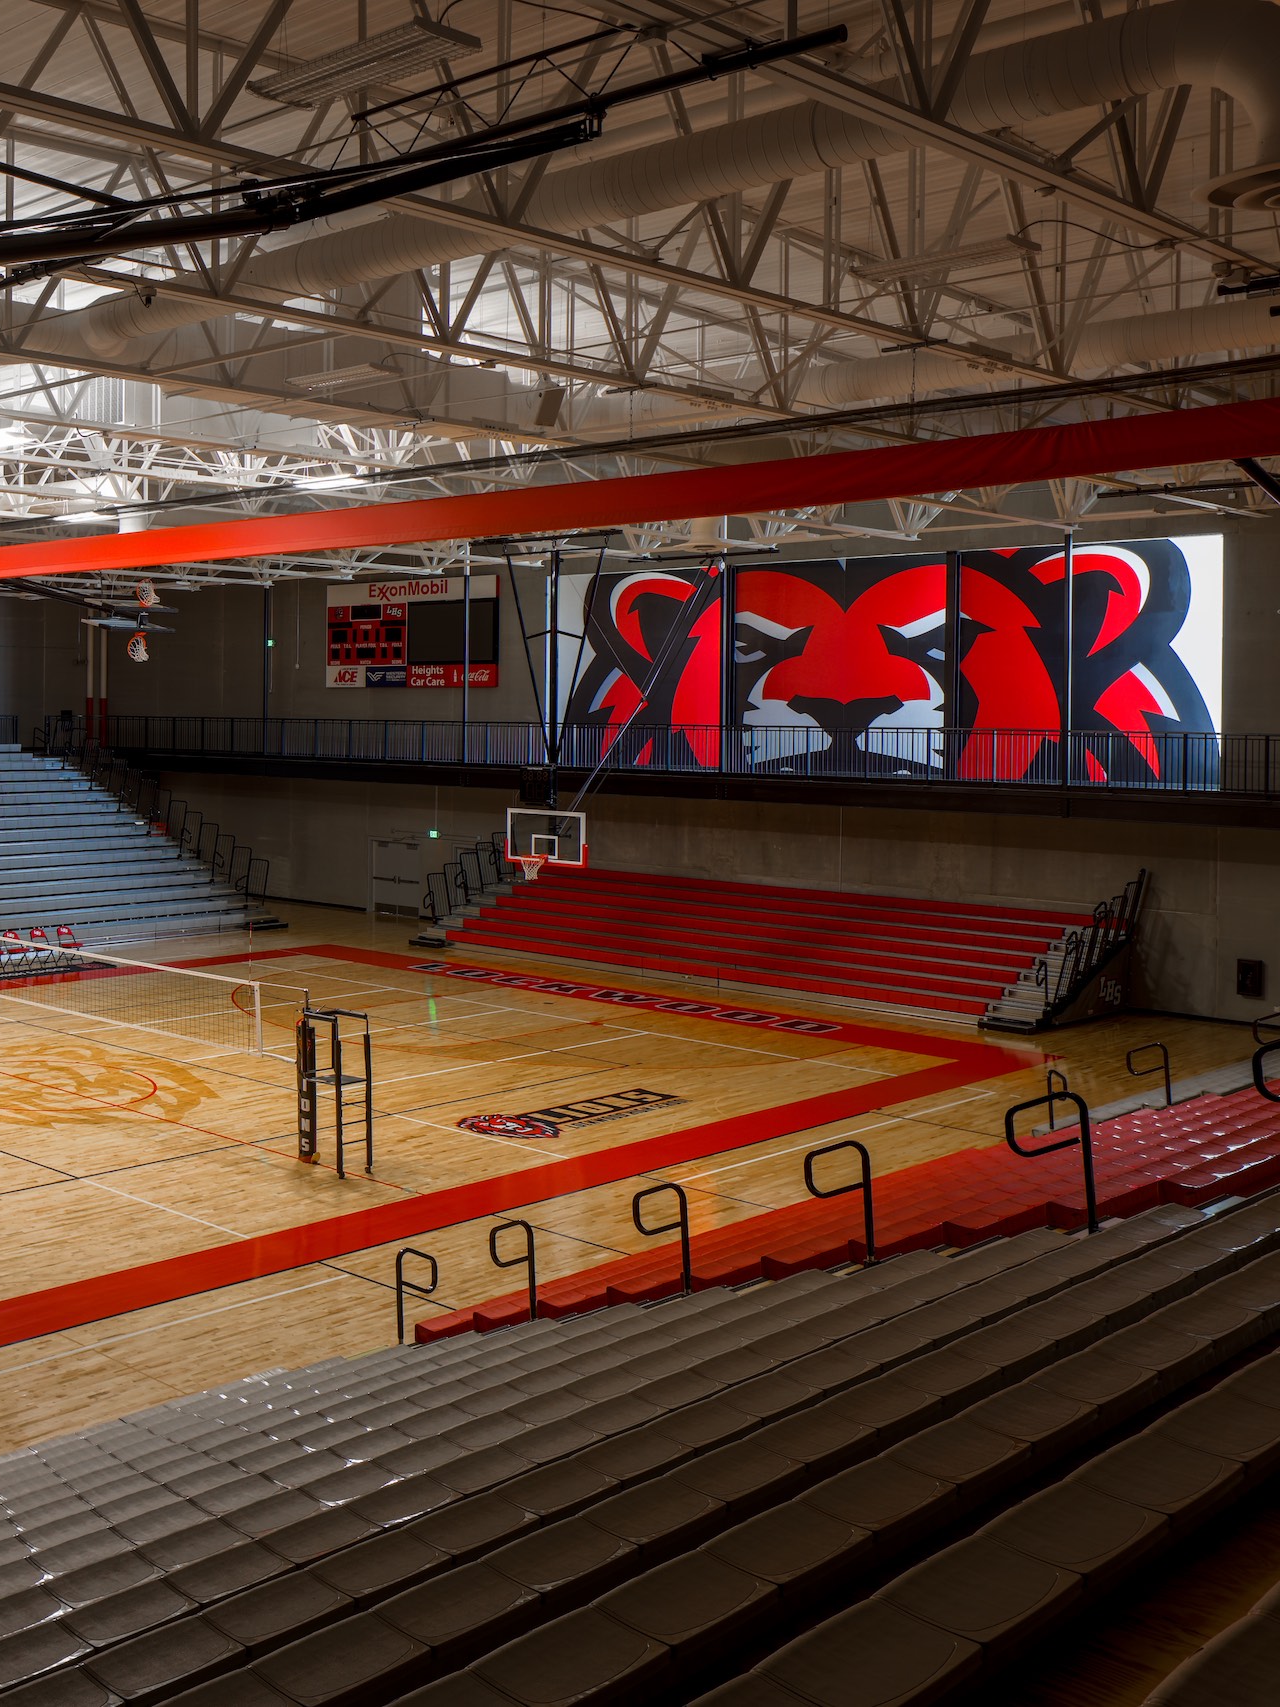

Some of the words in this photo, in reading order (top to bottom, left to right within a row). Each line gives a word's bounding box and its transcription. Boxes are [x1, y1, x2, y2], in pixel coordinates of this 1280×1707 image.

[369, 579, 448, 602] ExxonMobil
[386, 605, 403, 617] LHS
[334, 669, 358, 683] ACE
[410, 677, 425, 686] Car
[426, 677, 446, 686] Care
[412, 665, 444, 677] Heights
[407, 963, 843, 1033] LOCKWOOD
[1098, 976, 1122, 1005] LHS
[301, 1074, 311, 1152] IONS
[528, 1090, 664, 1124] LIONS
